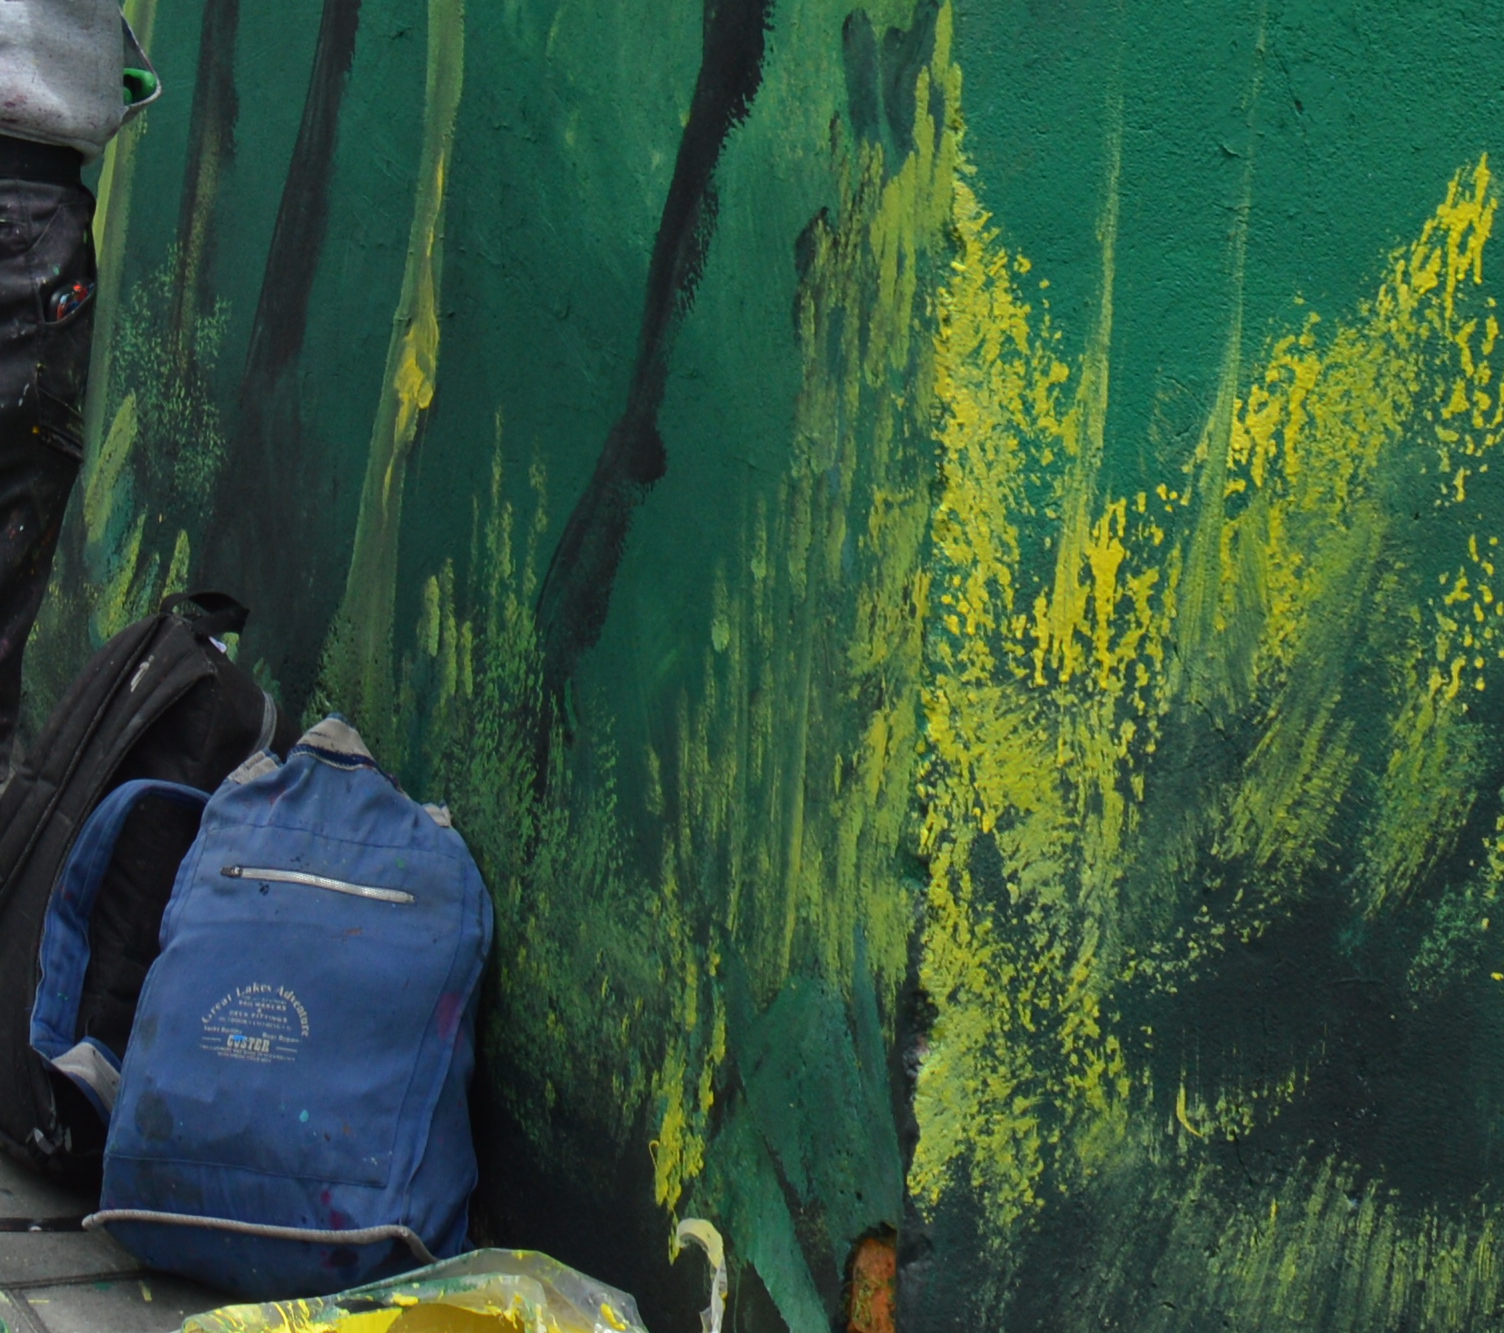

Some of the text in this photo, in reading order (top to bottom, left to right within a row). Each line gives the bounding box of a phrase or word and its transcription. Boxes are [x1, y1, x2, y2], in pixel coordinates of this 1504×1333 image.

[201, 993, 233, 1023] Great
[236, 982, 272, 998] Lakes
[276, 985, 310, 1037] Adventure
